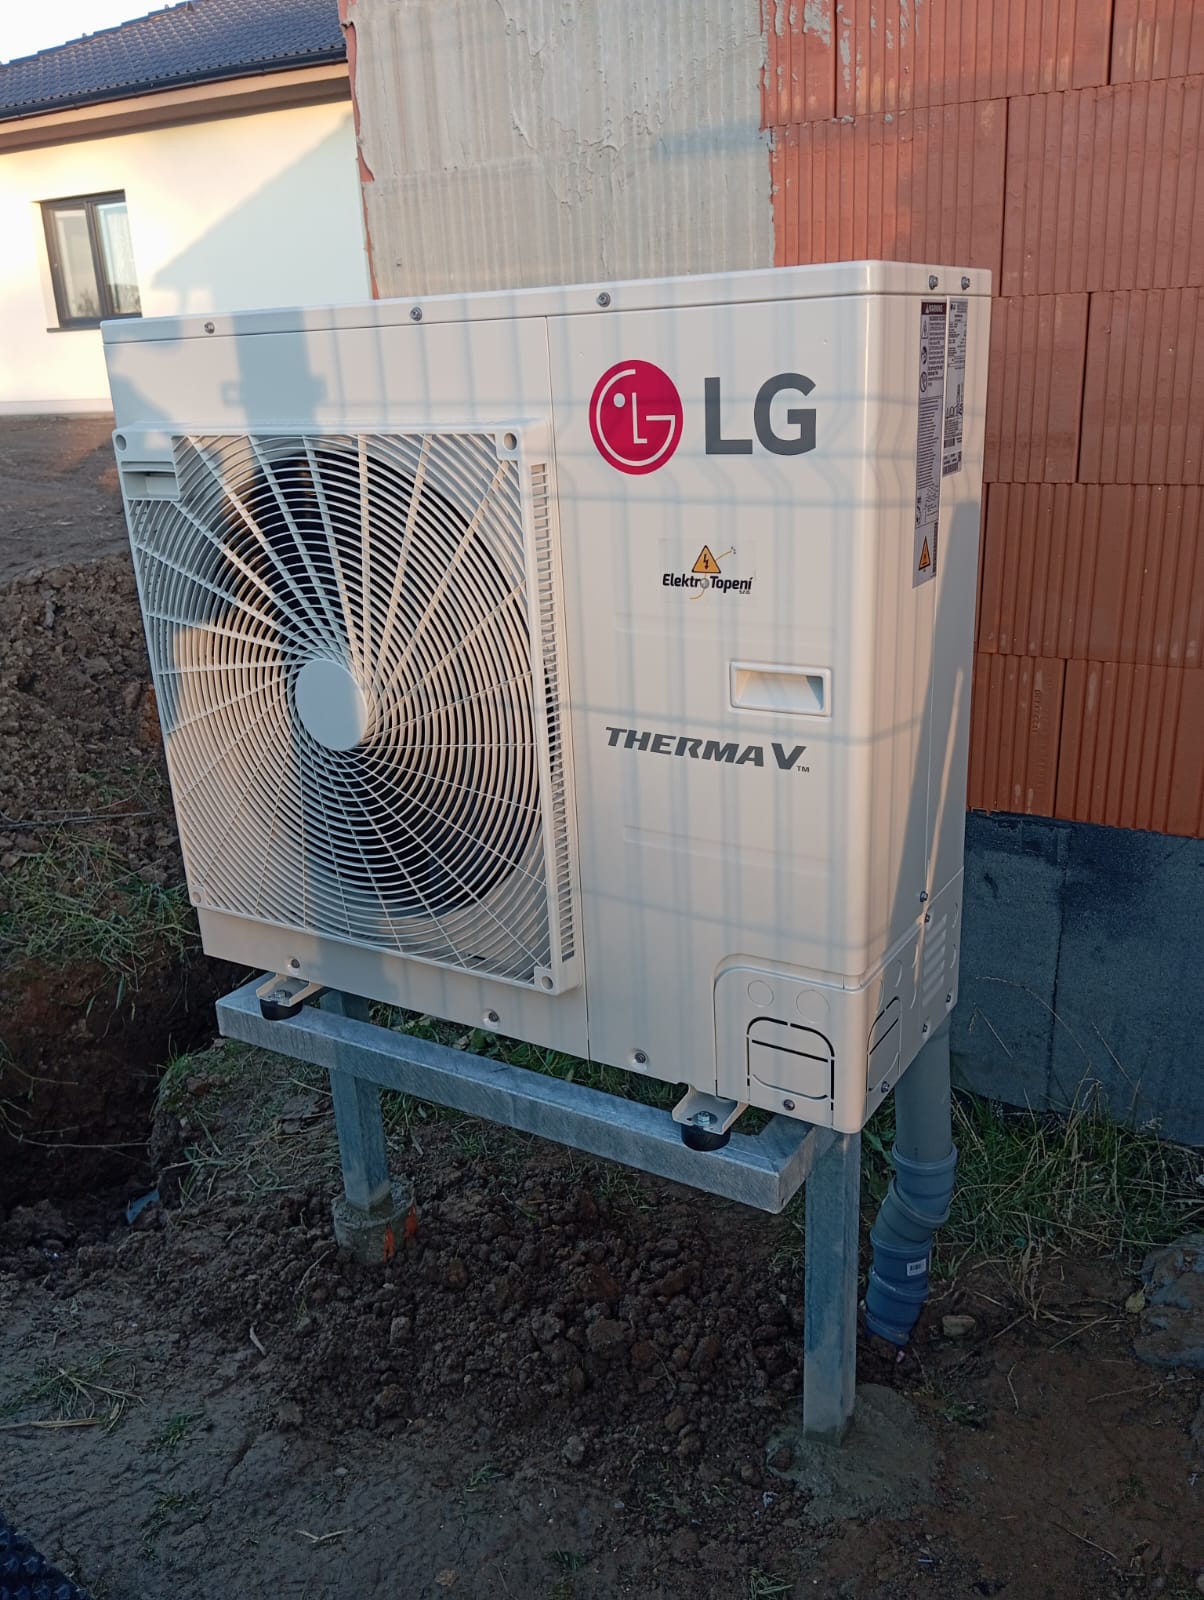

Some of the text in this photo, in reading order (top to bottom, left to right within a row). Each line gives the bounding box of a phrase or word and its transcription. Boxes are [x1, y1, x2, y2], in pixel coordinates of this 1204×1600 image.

[704, 372, 817, 456] LG
[605, 726, 764, 767] THERMA
[771, 742, 807, 770] V
